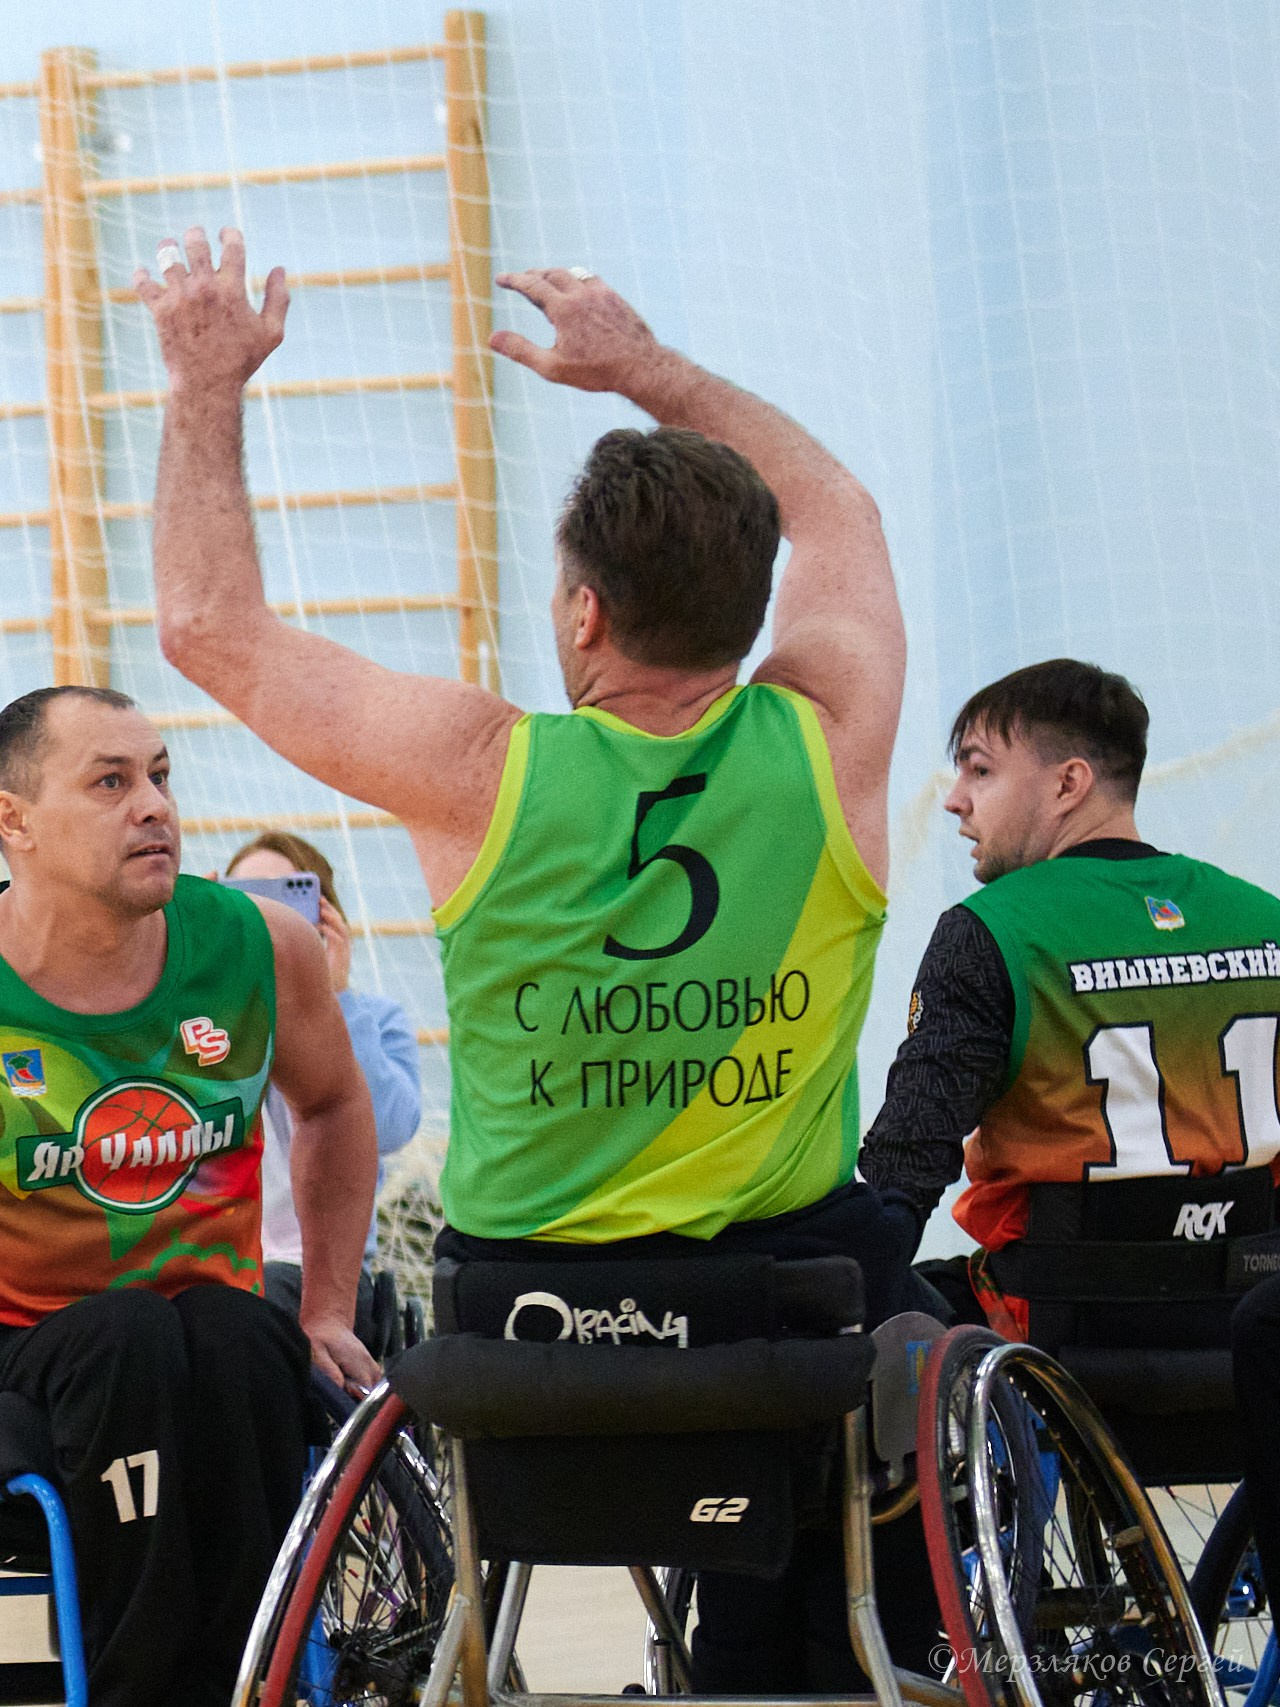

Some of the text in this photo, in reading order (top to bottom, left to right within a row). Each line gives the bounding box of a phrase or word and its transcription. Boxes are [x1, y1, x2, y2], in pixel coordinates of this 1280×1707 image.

[602, 772, 721, 961] 5
[514, 969, 811, 1035] С ЛЮБОВЬЮ
[529, 1048, 794, 1109] К ПРИРОДЕ
[100, 1449, 160, 1523] 17
